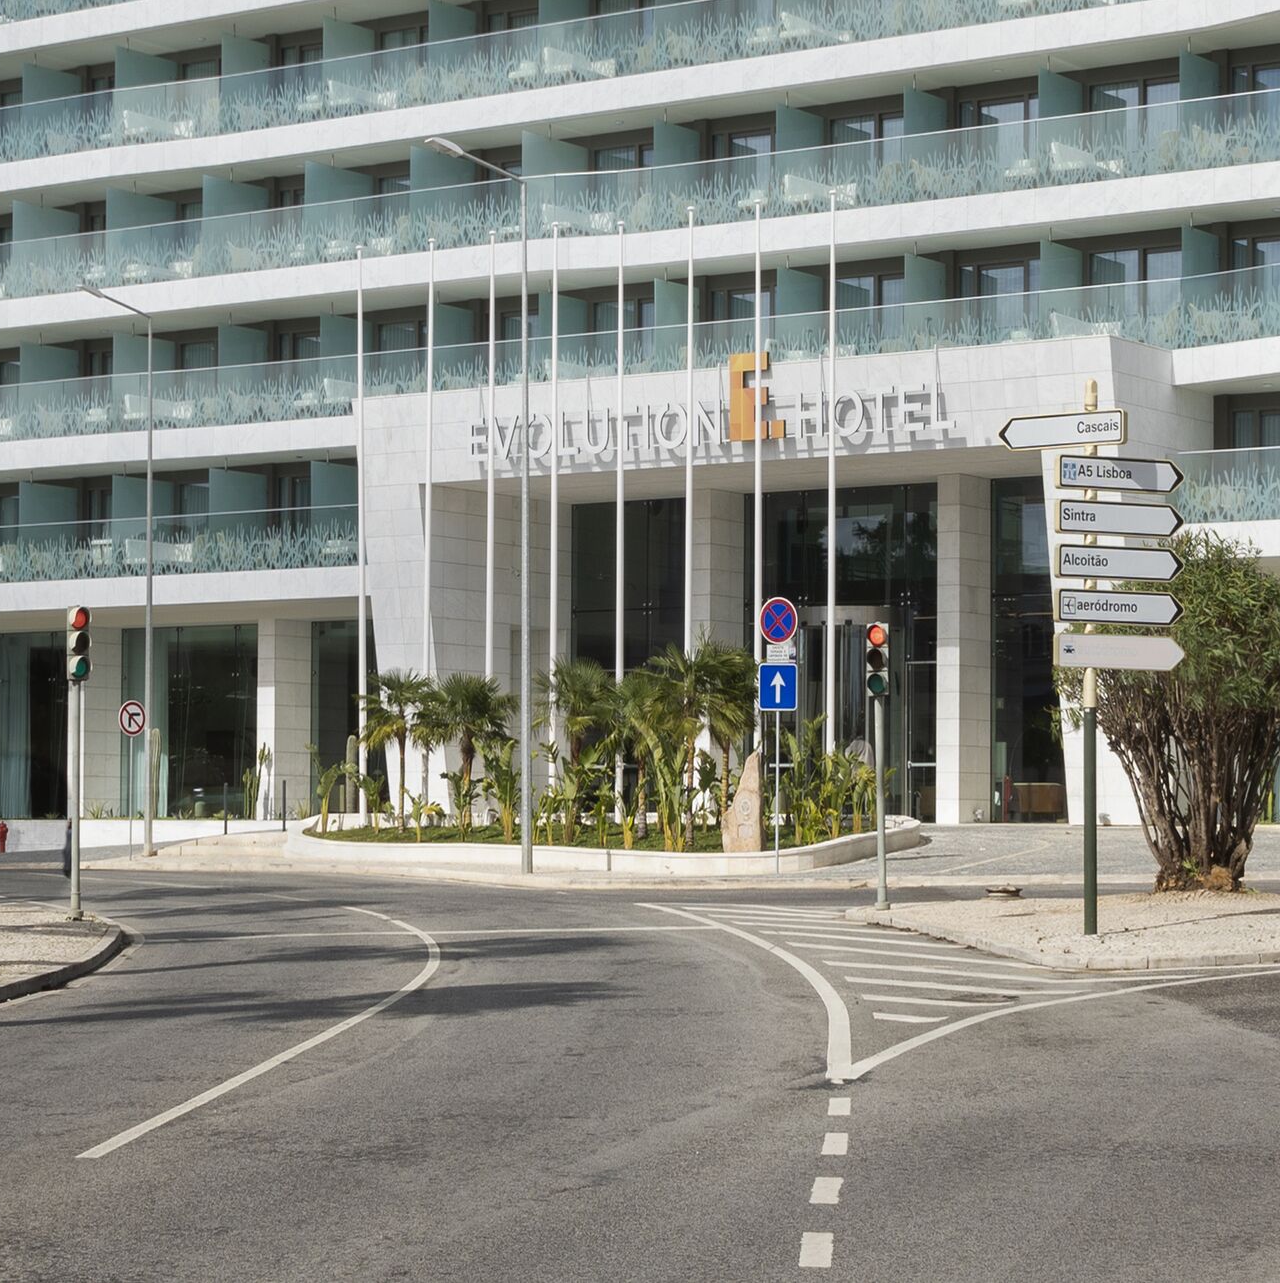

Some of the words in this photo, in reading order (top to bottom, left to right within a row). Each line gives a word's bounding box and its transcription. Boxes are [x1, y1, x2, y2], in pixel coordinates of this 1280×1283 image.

[470, 398, 722, 462] EVOLUTION
[795, 381, 957, 439] HOTEL
[1076, 419, 1119, 434] Cascais
[1077, 464, 1093, 478] A5
[1096, 465, 1132, 480] Lisboa
[1062, 507, 1096, 522] Sintra
[1062, 552, 1109, 567] Alcoitão
[1076, 599, 1138, 614] aeródromo
